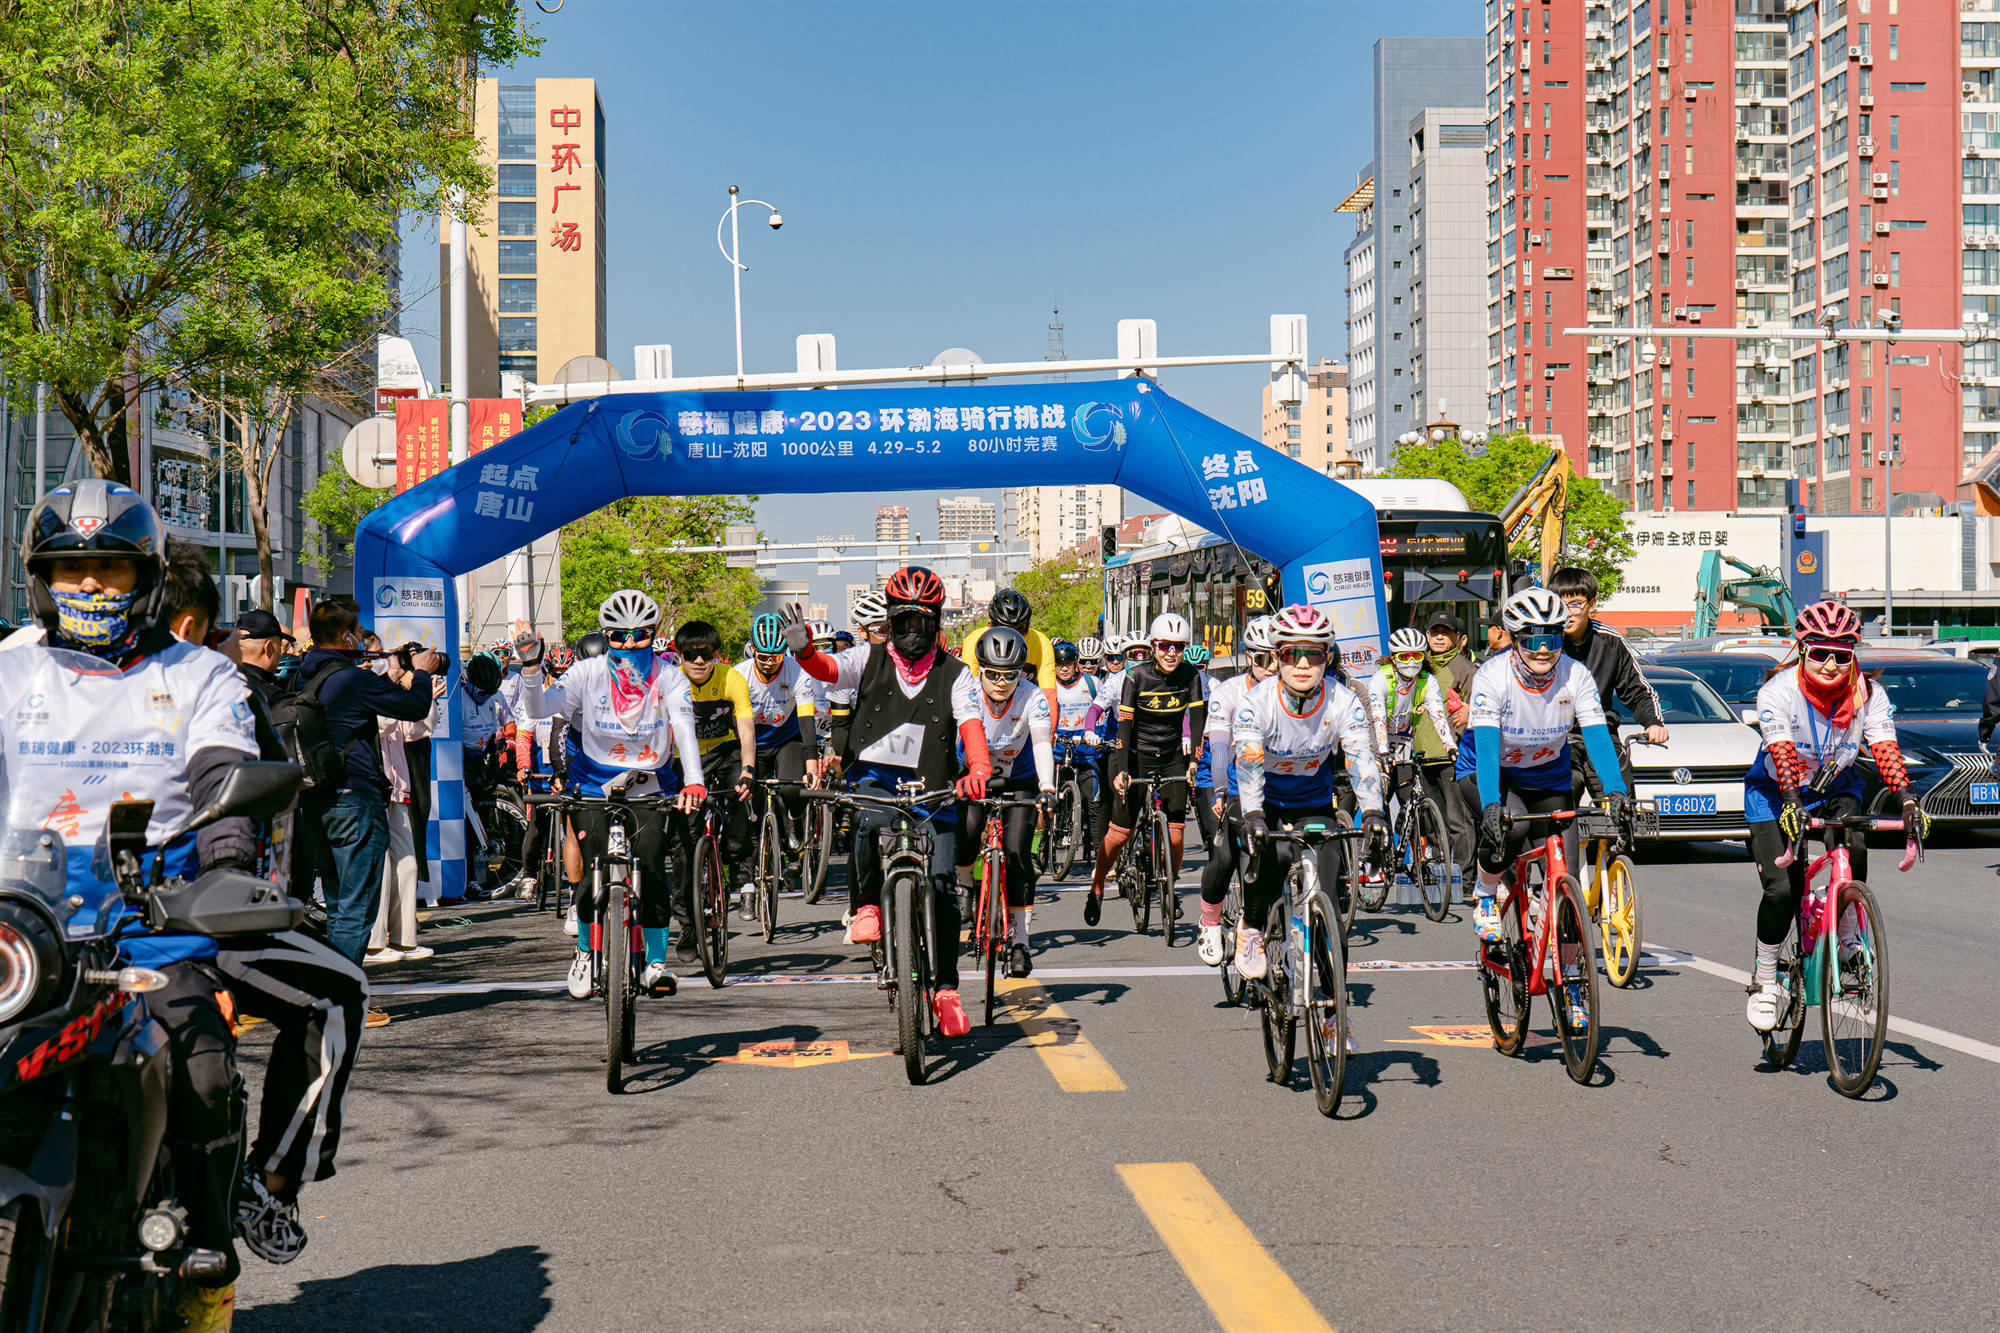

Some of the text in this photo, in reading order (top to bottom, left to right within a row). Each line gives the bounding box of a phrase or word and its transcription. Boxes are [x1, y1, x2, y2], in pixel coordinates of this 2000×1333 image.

[550, 104, 582, 252] 中环广场
[499, 412, 510, 443] 撸起
[780, 440, 854, 457] 1000公里
[968, 436, 1059, 453] 80小时完赛
[479, 463, 540, 492] 起点
[1201, 450, 1260, 481] 终点
[474, 491, 535, 523] 唐山
[1207, 477, 1268, 511] 沈阳
[1509, 513, 1531, 542] LOVOL
[1333, 570, 1371, 585] 慈瑞健康
[401, 589, 443, 601] 慈瑞健康
[1246, 589, 1266, 608] 59
[1389, 741, 1406, 754] 57
